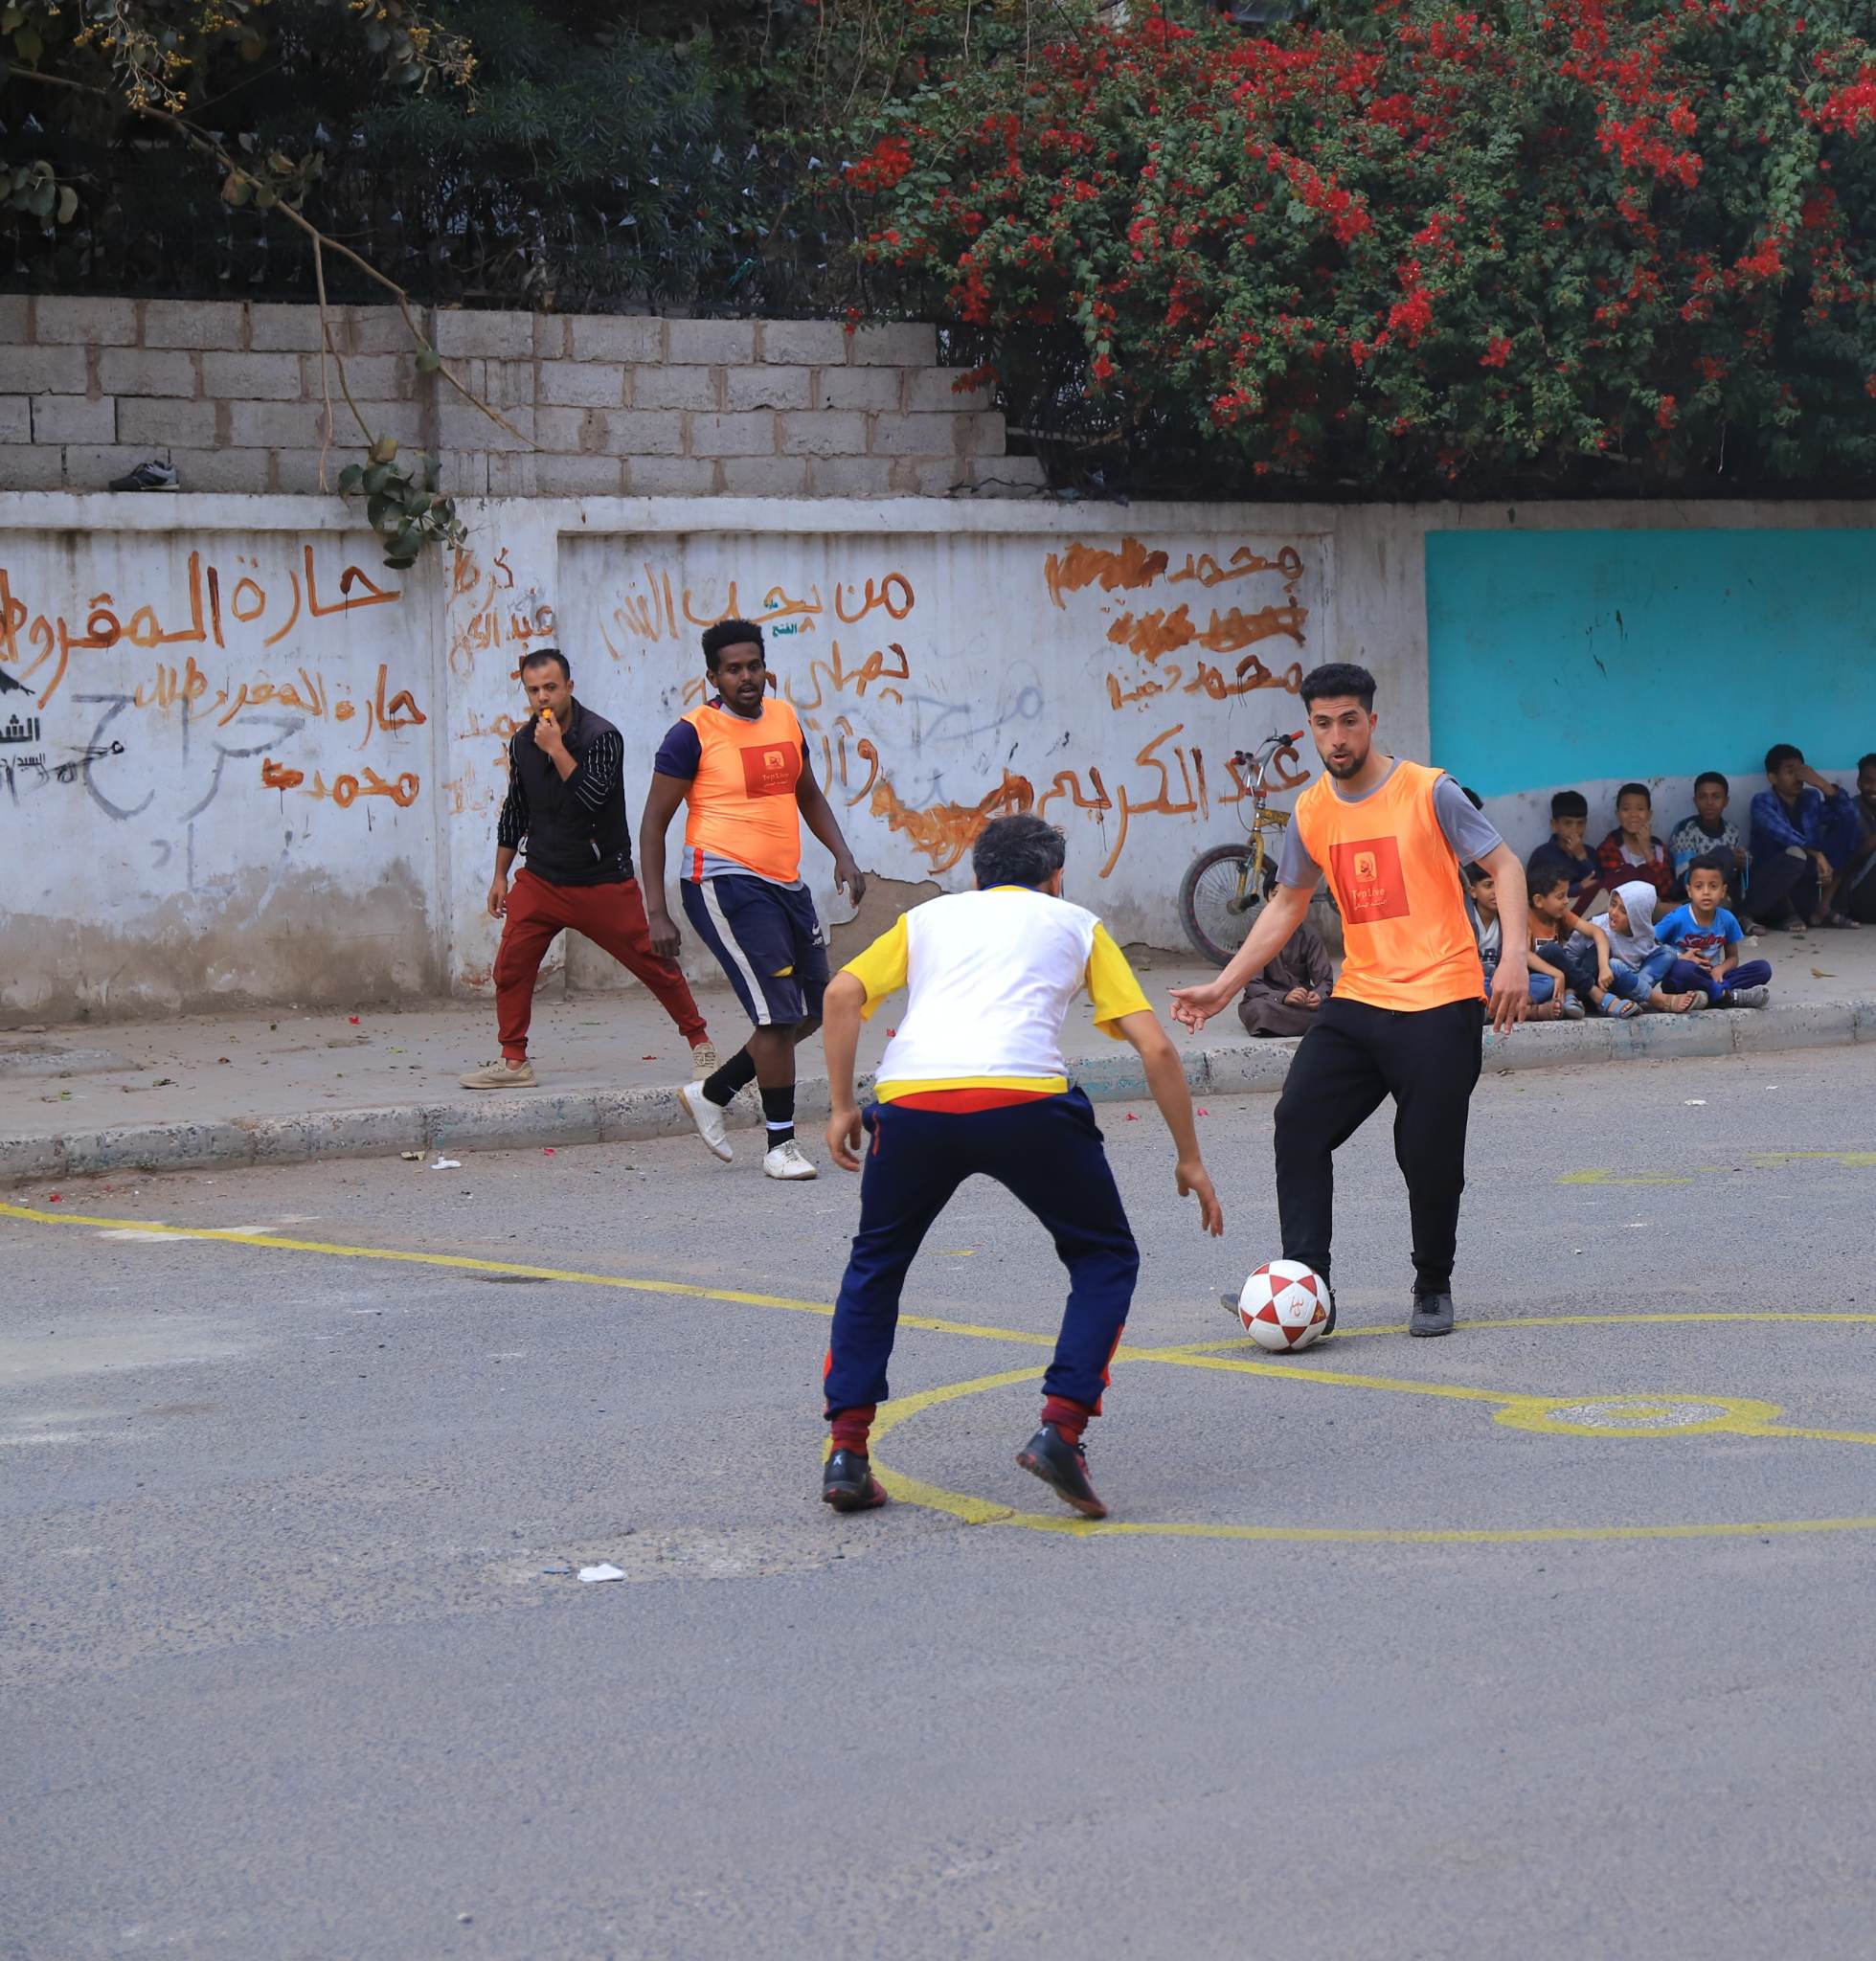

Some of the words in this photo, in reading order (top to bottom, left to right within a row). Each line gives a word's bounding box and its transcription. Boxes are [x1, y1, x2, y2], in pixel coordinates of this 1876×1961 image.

[1167, 546, 1304, 588] محمد
[232, 545, 401, 648] حارة
[836, 572, 915, 624] من
[1182, 654, 1303, 701] محمد
[296, 765, 420, 809] محمد
